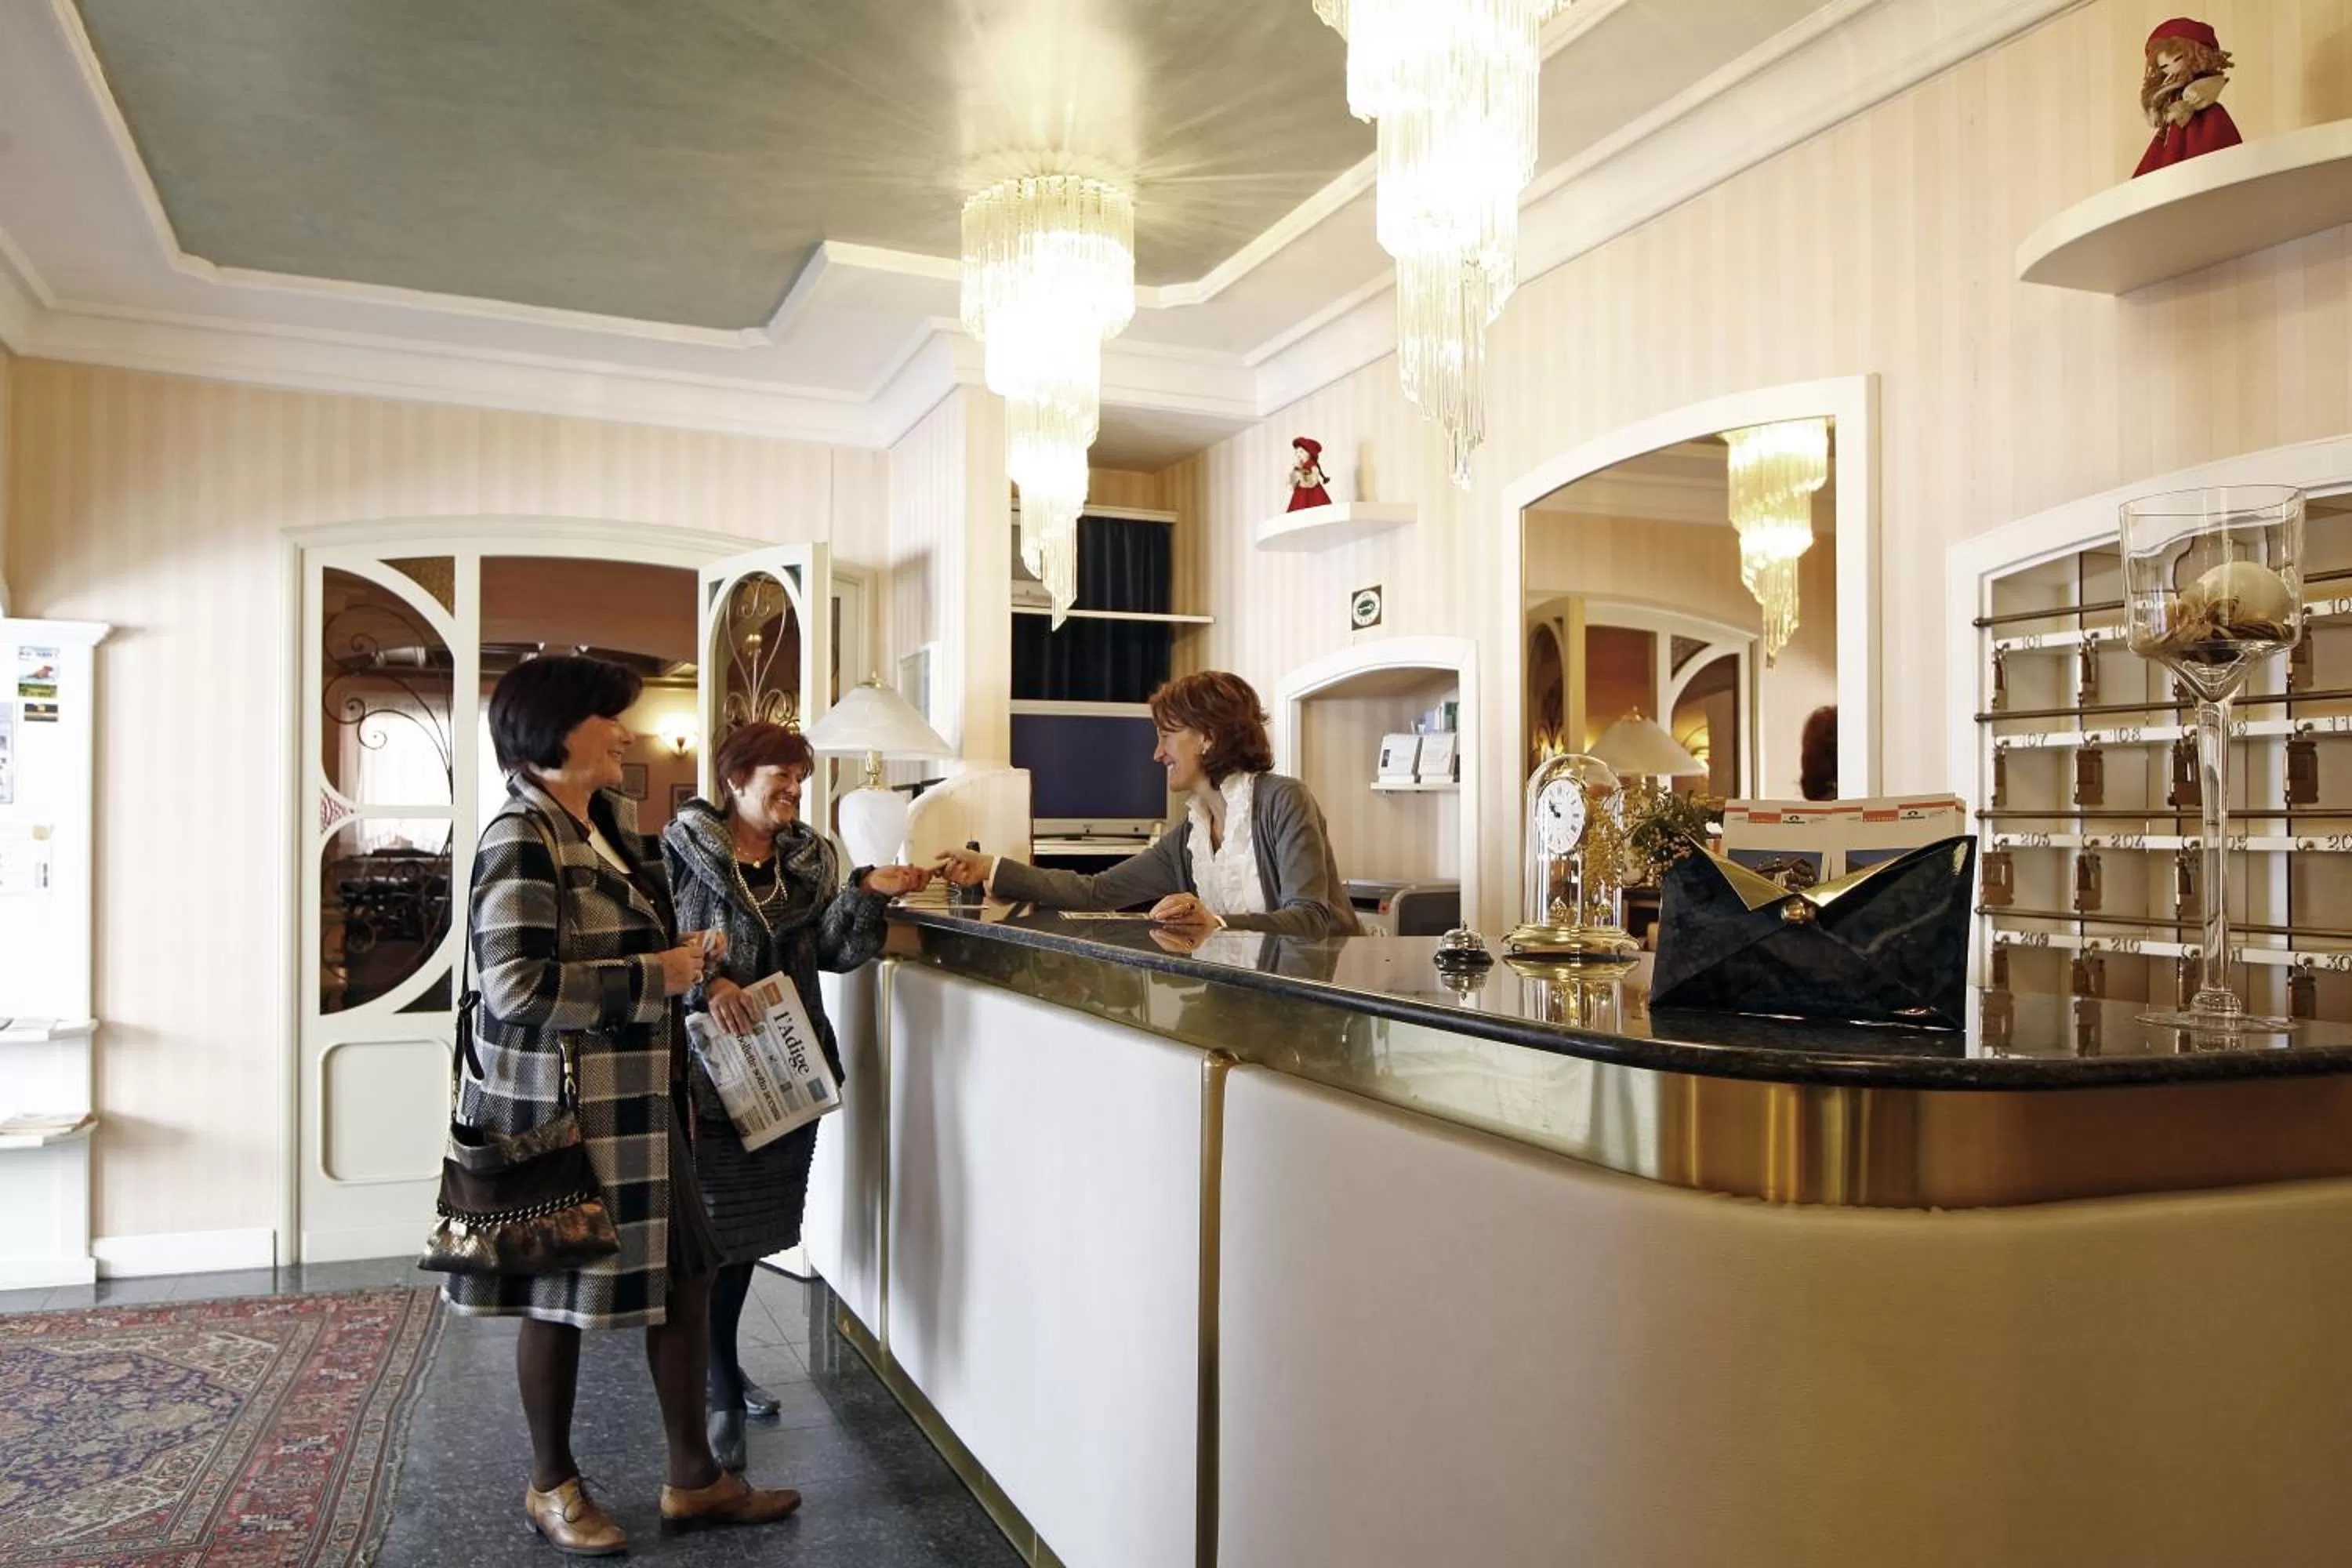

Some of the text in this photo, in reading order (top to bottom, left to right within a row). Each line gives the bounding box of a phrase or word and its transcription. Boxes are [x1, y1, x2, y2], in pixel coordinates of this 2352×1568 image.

[2019, 731, 2048, 747] 107
[2111, 728, 2142, 743] 108
[2020, 832, 2051, 848] 203
[2110, 833, 2147, 849] 204
[2326, 833, 2352, 851] 20
[2020, 931, 2049, 947] 209
[2110, 937, 2141, 954] 210
[2326, 953, 2352, 971] 30
[772, 1011, 810, 1076] l'Adige
